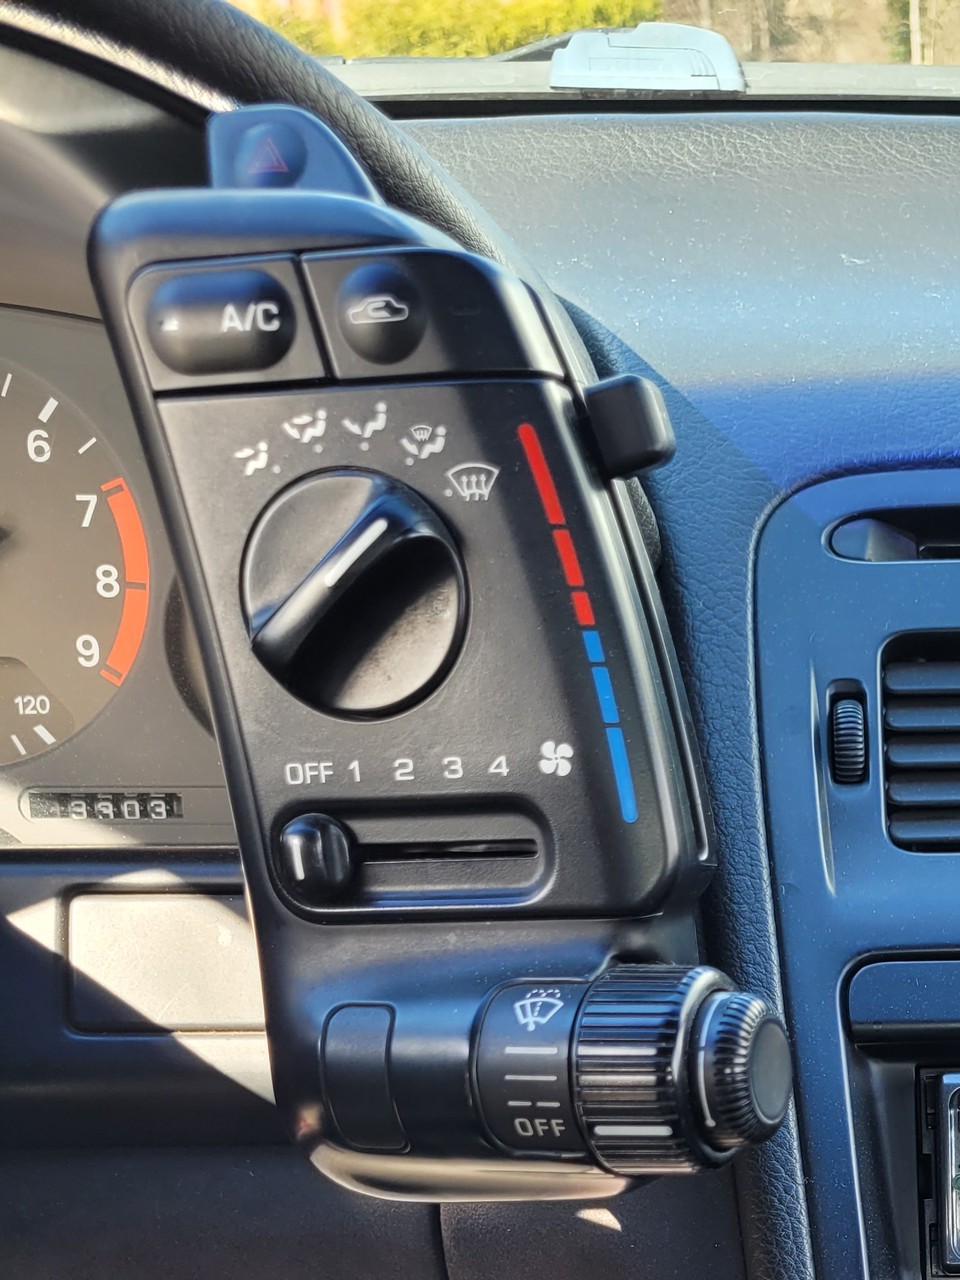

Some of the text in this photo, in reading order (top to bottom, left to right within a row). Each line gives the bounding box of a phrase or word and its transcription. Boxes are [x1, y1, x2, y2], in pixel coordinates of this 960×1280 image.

[221, 303, 280, 332] A/C
[27, 429, 51, 462] 6
[75, 494, 97, 527] 7
[96, 564, 120, 598] 8
[75, 634, 100, 667] 9
[14, 695, 50, 715] 120
[285, 756, 510, 785] OFF 1 2 3 4
[514, 1118, 566, 1138] OFF
